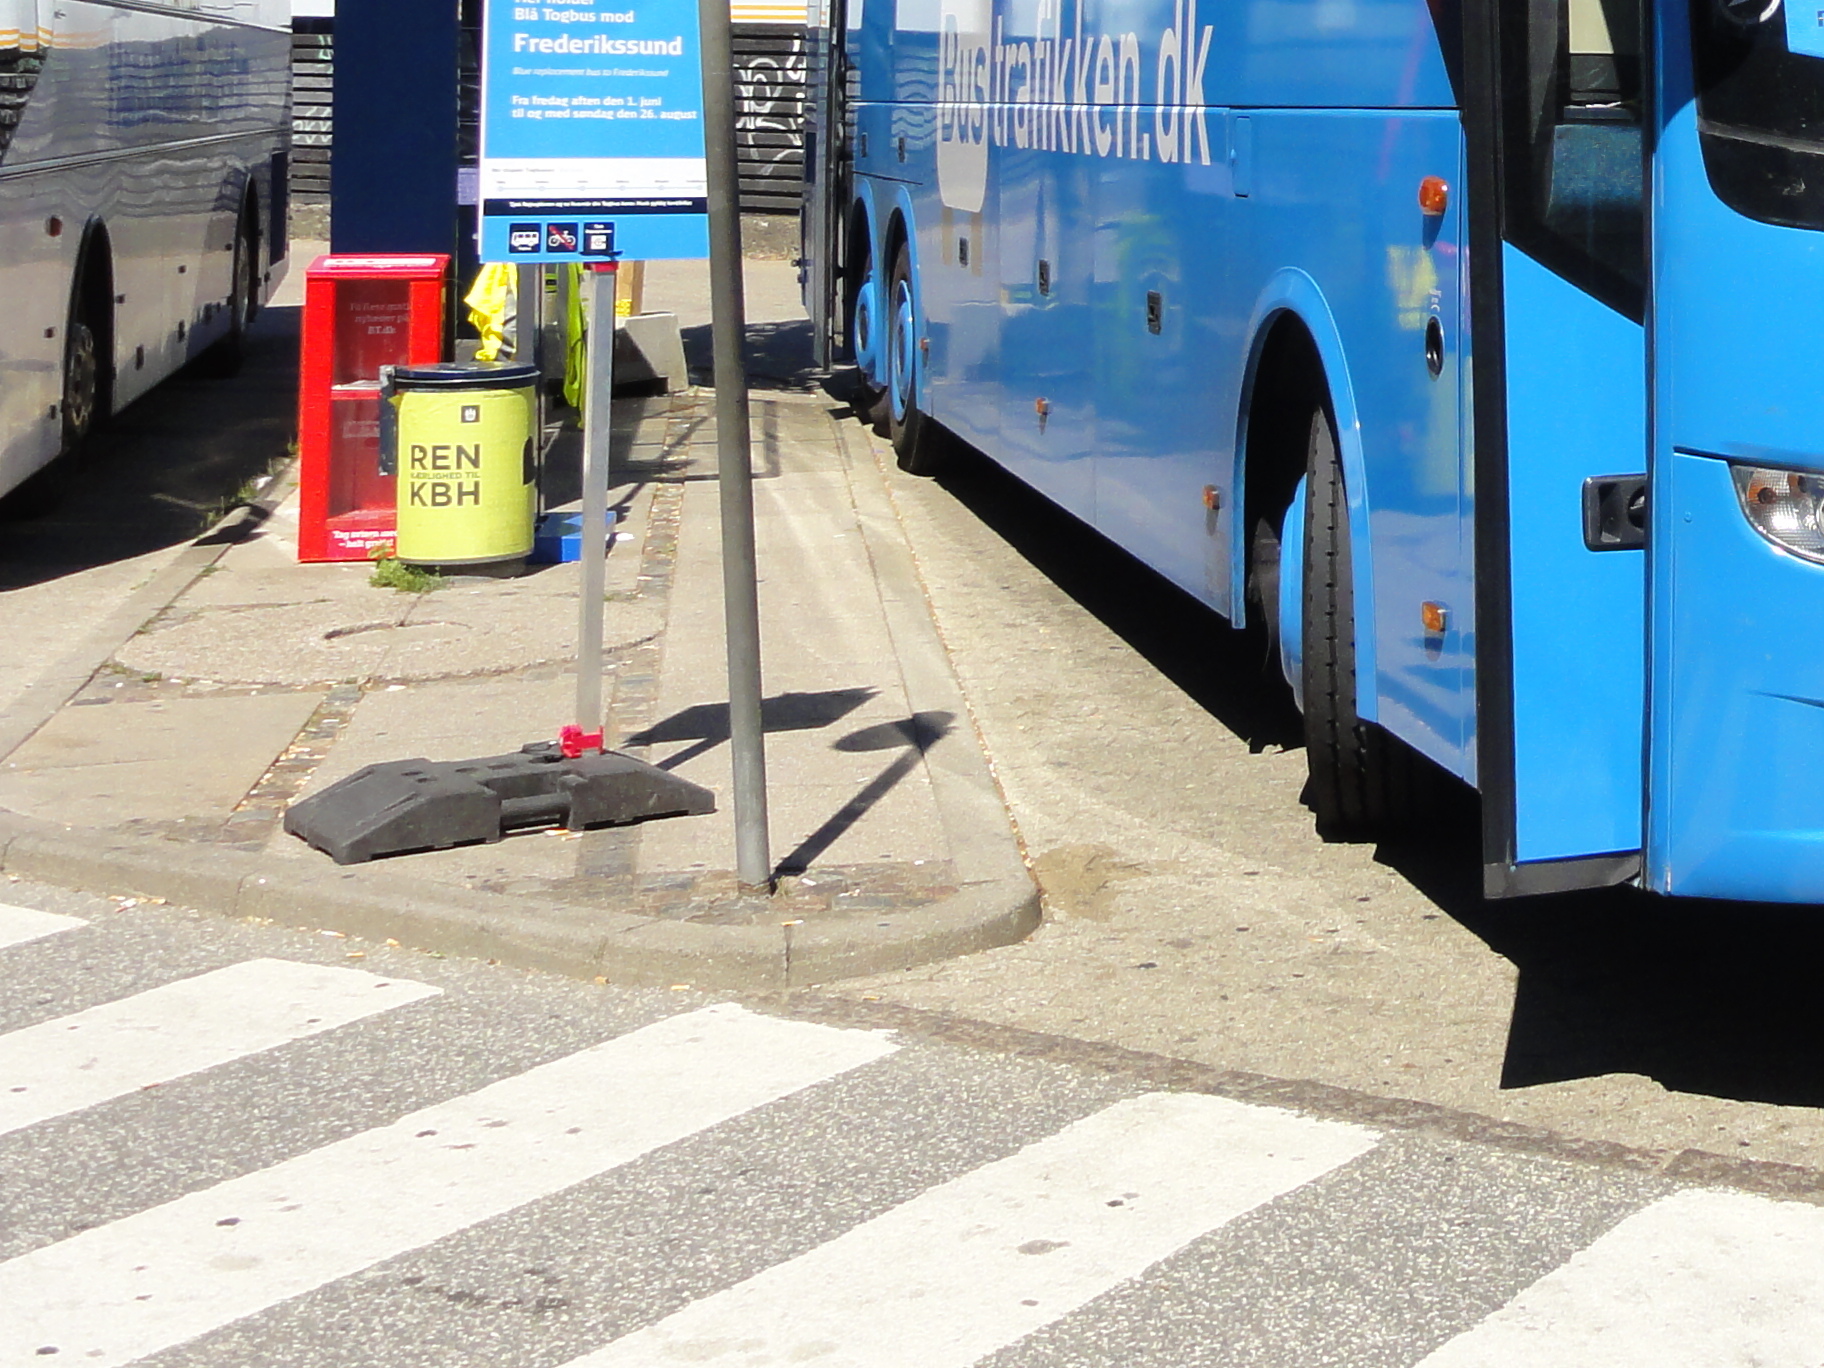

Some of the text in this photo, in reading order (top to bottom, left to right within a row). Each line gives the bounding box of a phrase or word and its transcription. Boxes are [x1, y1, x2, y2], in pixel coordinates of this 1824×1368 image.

[513, 6, 635, 24] Blå Togbus mod
[513, 33, 683, 55] Frederikssund
[941, 13, 987, 146] Bus
[512, 95, 529, 106] Fra
[531, 95, 569, 107] fredag
[603, 96, 624, 106] den
[639, 96, 662, 108] juni
[512, 108, 524, 119] til
[527, 109, 543, 120] og
[545, 108, 571, 119] med
[616, 109, 638, 119] den
[660, 110, 698, 121] august
[410, 444, 481, 471] REN
[410, 482, 481, 507] KBH
